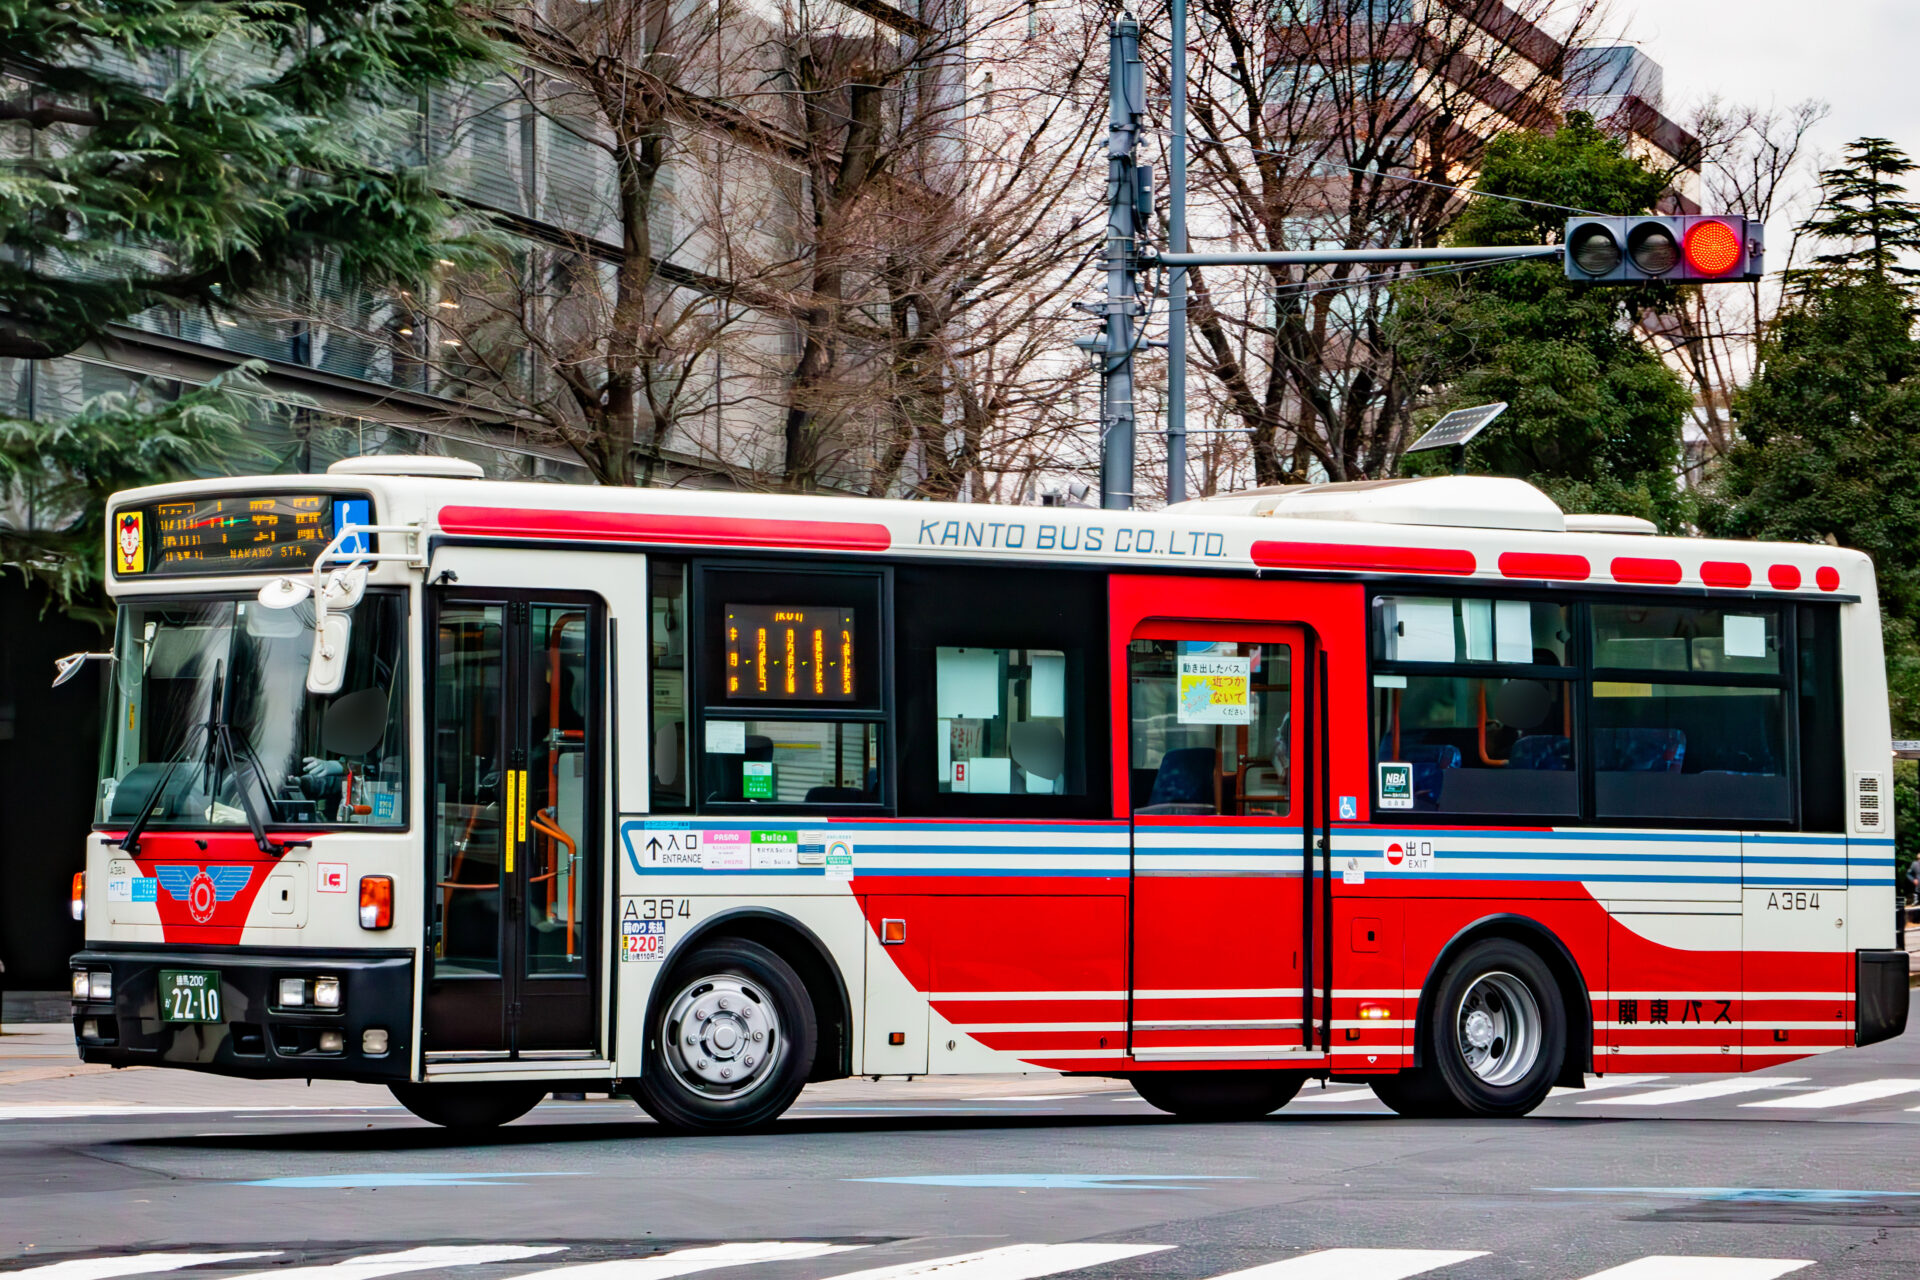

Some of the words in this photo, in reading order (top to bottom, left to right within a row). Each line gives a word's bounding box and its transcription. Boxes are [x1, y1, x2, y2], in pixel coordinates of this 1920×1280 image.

[918, 519, 1025, 548] KANTO
[1036, 525, 1104, 551] BUS
[230, 548, 273, 559] NAKANO
[281, 546, 307, 557] STA.
[1386, 773, 1406, 785] NBA
[667, 834, 697, 851] 入口
[713, 833, 740, 841] PASMO
[760, 833, 788, 842] Suica
[1405, 841, 1431, 857] 出口
[662, 853, 702, 864] ENTRANCE
[1408, 859, 1428, 869] EXIT
[623, 899, 692, 919] A364
[1766, 892, 1820, 911] A364
[629, 936, 657, 953] 220
[1618, 999, 1732, 1025] 関東バス
